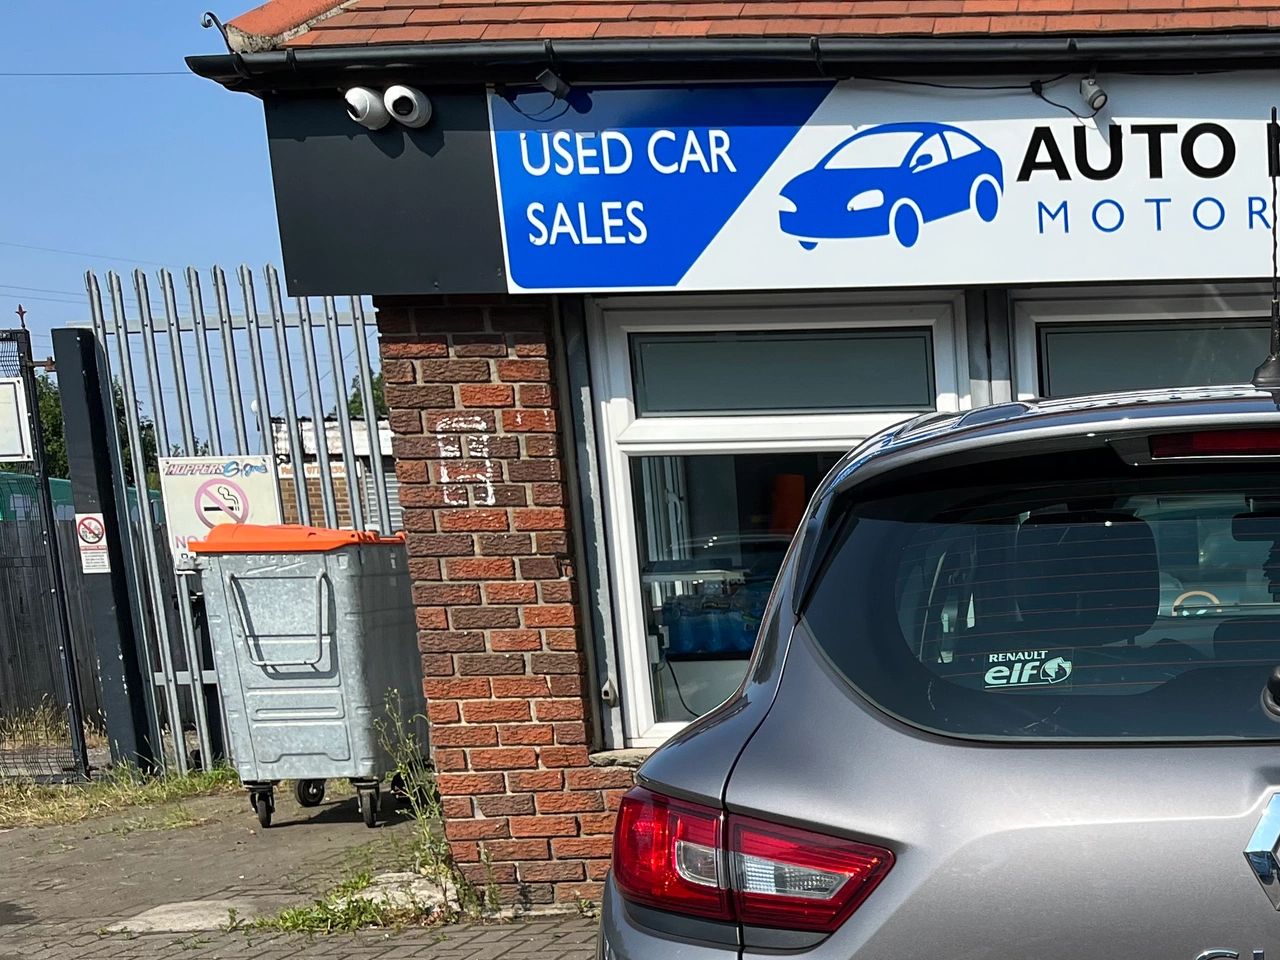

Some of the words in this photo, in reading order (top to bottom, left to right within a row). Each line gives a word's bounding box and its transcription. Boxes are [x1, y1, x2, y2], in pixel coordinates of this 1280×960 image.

[520, 129, 633, 176] USED
[647, 129, 737, 174] CAR
[1016, 122, 1236, 182] AUTO
[527, 200, 647, 245] SALES
[1037, 196, 1273, 234] MOTOR
[165, 464, 226, 476] HOPPERS
[984, 661, 1040, 685] elf
[989, 650, 1048, 662] RENAULT
